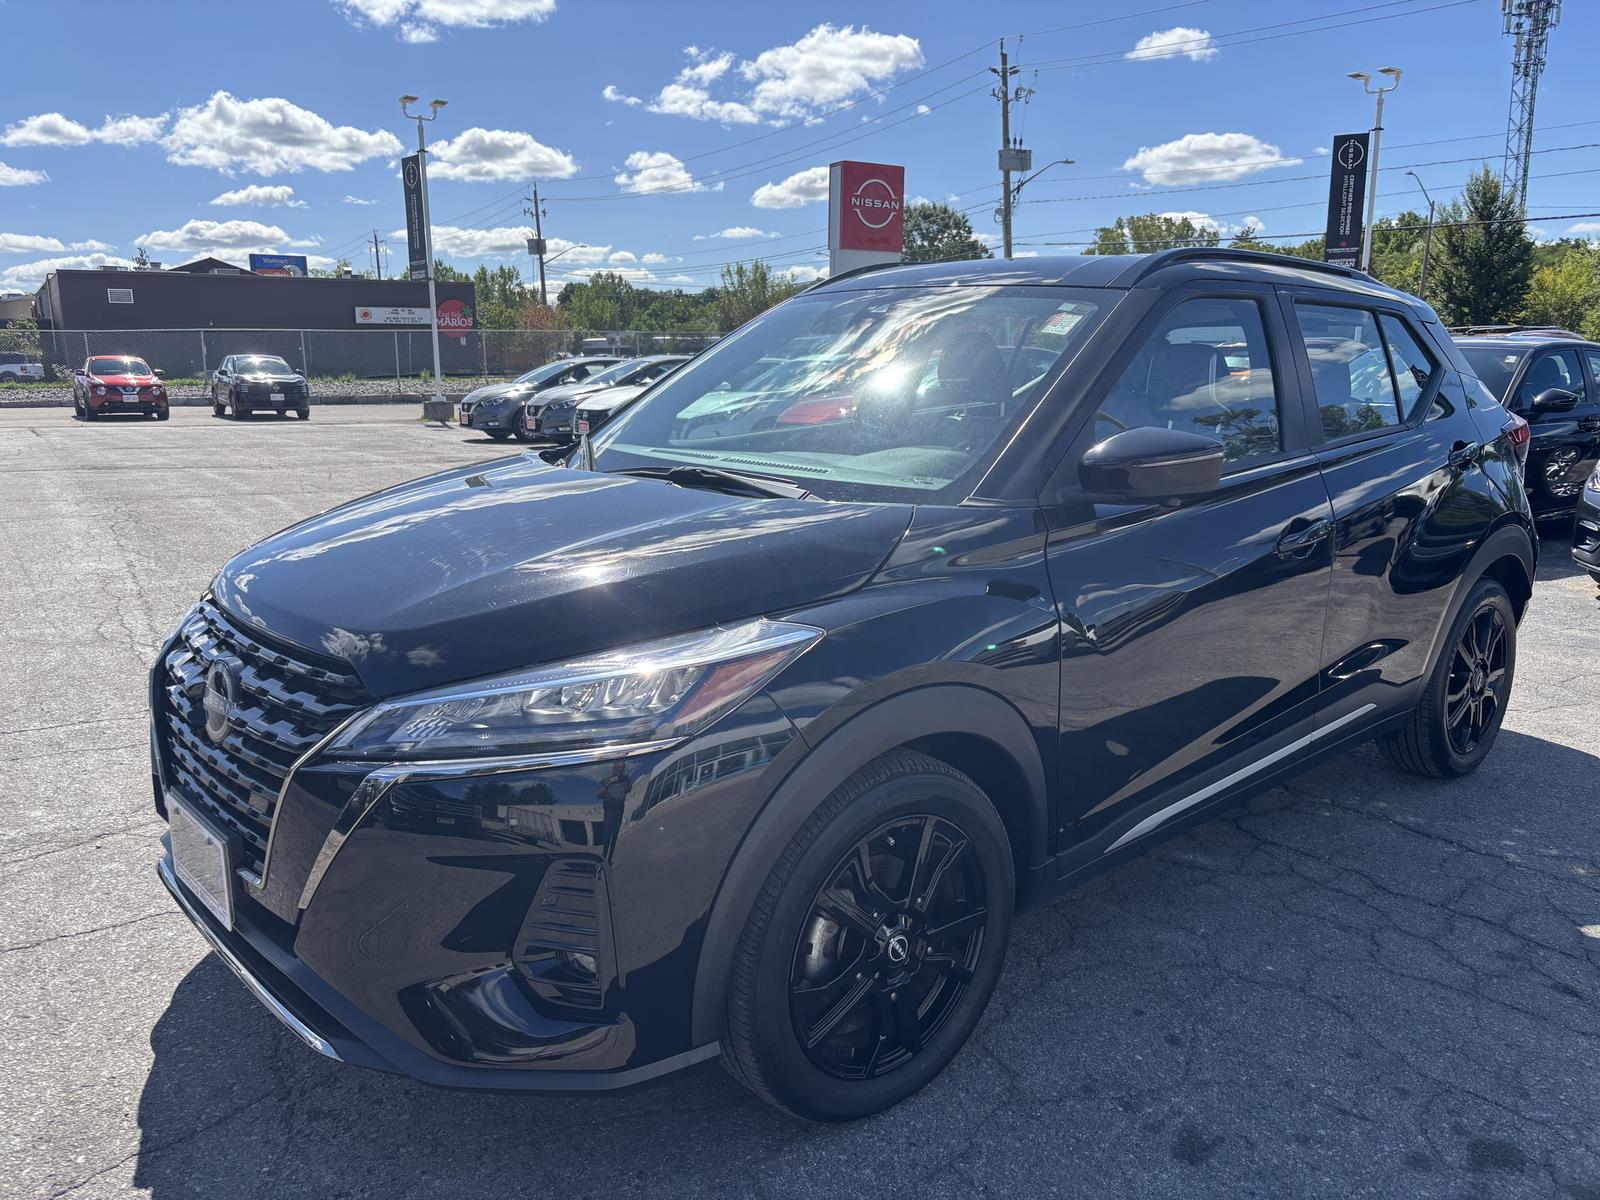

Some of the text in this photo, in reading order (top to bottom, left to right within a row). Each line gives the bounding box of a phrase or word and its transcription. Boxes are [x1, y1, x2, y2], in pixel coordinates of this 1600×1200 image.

[1347, 139, 1355, 170] NISSAN
[851, 197, 900, 210] NISSAN
[1339, 175, 1349, 235] INTELLIGENT SELECTION
[1344, 174, 1355, 235] CERTIFIED PRE-OWNED
[262, 257, 288, 265] Walmart
